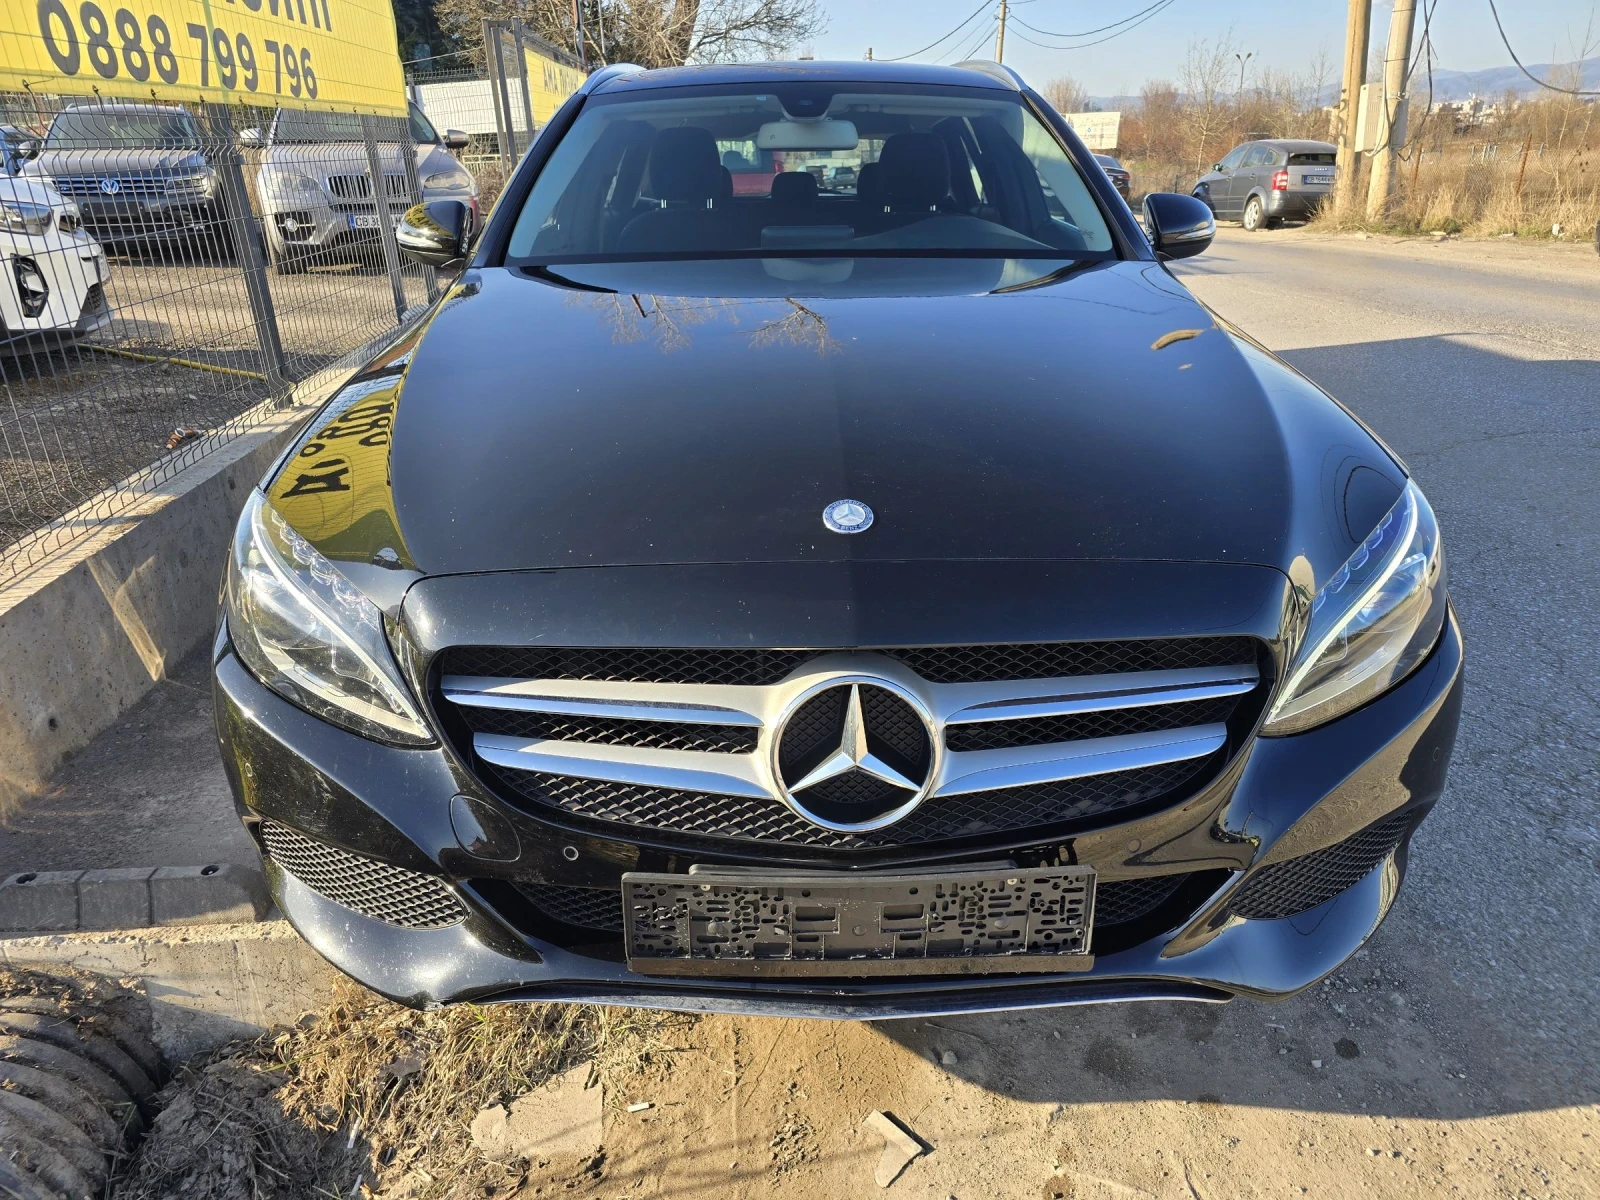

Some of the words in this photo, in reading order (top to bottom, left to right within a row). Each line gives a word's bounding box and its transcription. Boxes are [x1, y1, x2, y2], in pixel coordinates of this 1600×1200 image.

[37, 0, 179, 84] 0888
[186, 22, 258, 92] 799
[264, 39, 318, 100] 796
